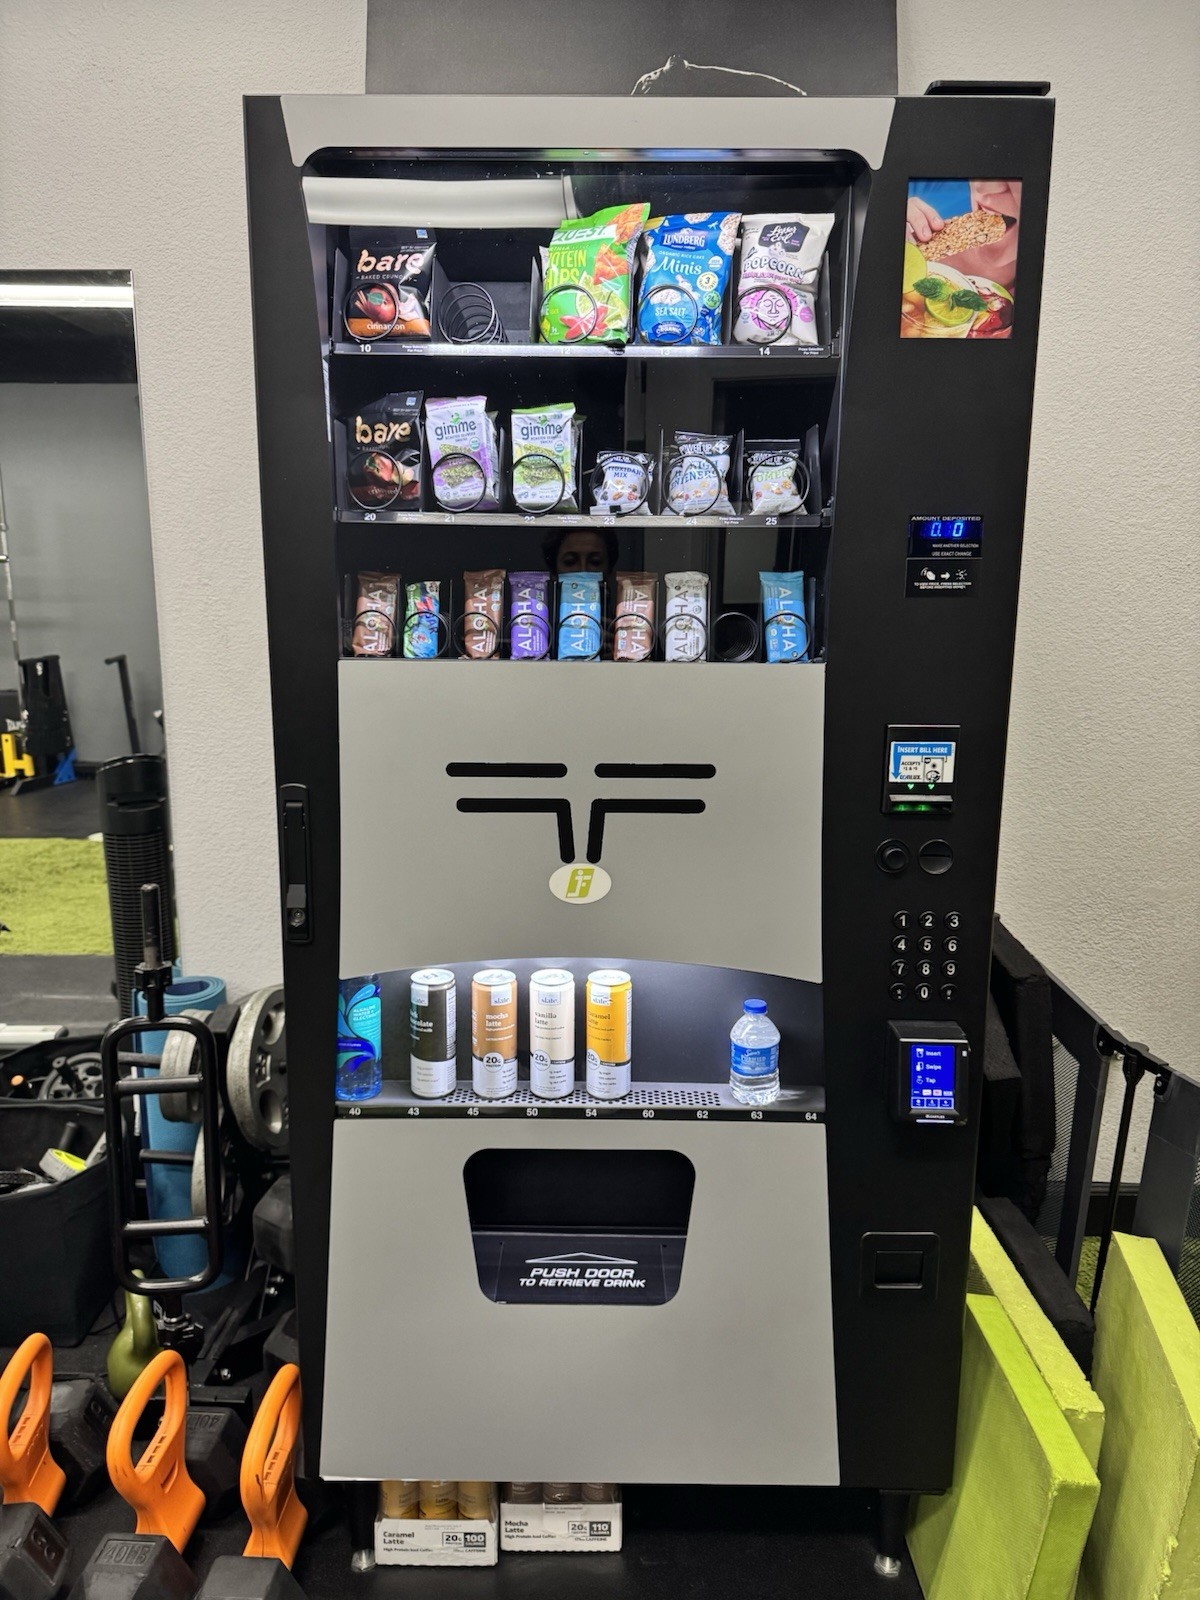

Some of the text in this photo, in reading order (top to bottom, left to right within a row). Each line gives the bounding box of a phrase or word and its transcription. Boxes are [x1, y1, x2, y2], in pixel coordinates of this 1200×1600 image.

[663, 234, 705, 248] LUNDBERG
[356, 249, 424, 275] bare
[652, 256, 702, 275] Minis
[744, 256, 805, 280] POPCORN
[655, 307, 686, 317] SEA SALT
[360, 344, 371, 352] 10
[759, 348, 770, 356] 14
[356, 416, 411, 444] bare
[434, 420, 477, 441] gimme
[520, 422, 563, 441] gimme
[756, 470, 788, 482] OMEG
[766, 517, 777, 525] 25
[363, 590, 382, 651] ALOHA
[472, 588, 487, 652] ALOHA
[518, 588, 532, 651] ALOHA
[571, 589, 586, 652] ALOHA
[631, 590, 648, 653] ALOHA
[674, 590, 688, 655] ALOHA
[779, 587, 797, 652] ALOHA
[899, 915, 959, 927] 1 2 3
[898, 939, 957, 952] 4 5 6
[897, 963, 955, 975] 7 8 9
[921, 987, 928, 998] 0
[408, 1108, 420, 1116] 43
[467, 1108, 479, 1116] 45
[526, 1108, 538, 1116] 50
[585, 1109, 597, 1117] 54
[642, 1110, 654, 1118] 60
[697, 1111, 708, 1119] 62
[751, 1111, 763, 1119] 63
[805, 1112, 817, 1121] 64
[530, 1268, 634, 1278] PUSH DOOR
[519, 1278, 646, 1288] TO RETRIEVE DRINK
